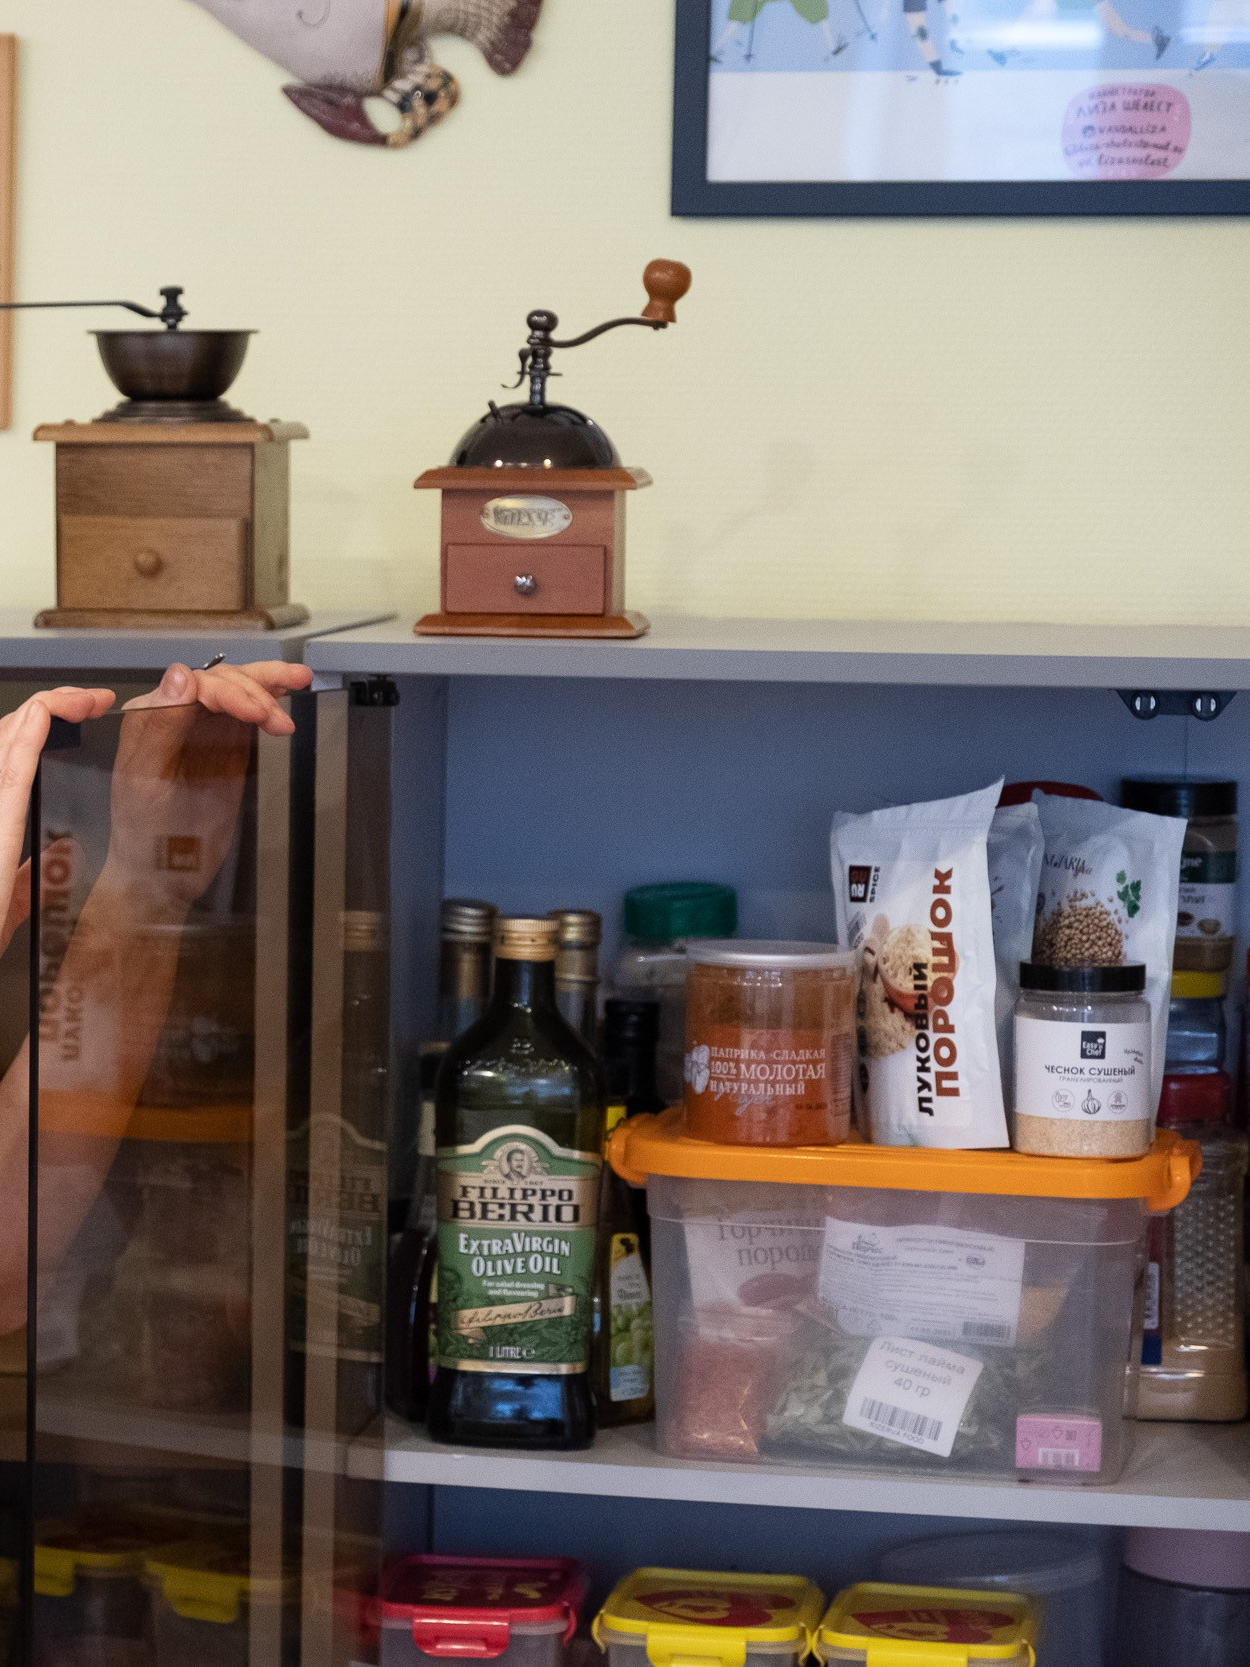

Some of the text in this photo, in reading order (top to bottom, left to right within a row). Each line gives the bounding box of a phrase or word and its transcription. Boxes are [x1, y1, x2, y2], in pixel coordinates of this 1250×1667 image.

[929, 867, 961, 1097] ПОРОШОК
[909, 962, 934, 1117] ЛУКОВЫЙ
[711, 1046, 766, 1060] ПАПРИКА
[710, 1061, 827, 1081] 100% МОЛОТАЯ
[1044, 1064, 1136, 1077] ЧЕСНОК СУШЕНЫЙ
[710, 1080, 806, 1096] НАТУРАЛЬНЫЙ
[460, 1185, 573, 1201] FILIPPO
[451, 1200, 581, 1224] BERIO
[471, 1253, 562, 1277] OLIVE OIL
[879, 1340, 966, 1376] Лист лайма
[885, 1359, 952, 1386] сушеный
[893, 1377, 932, 1399] 40 гр
